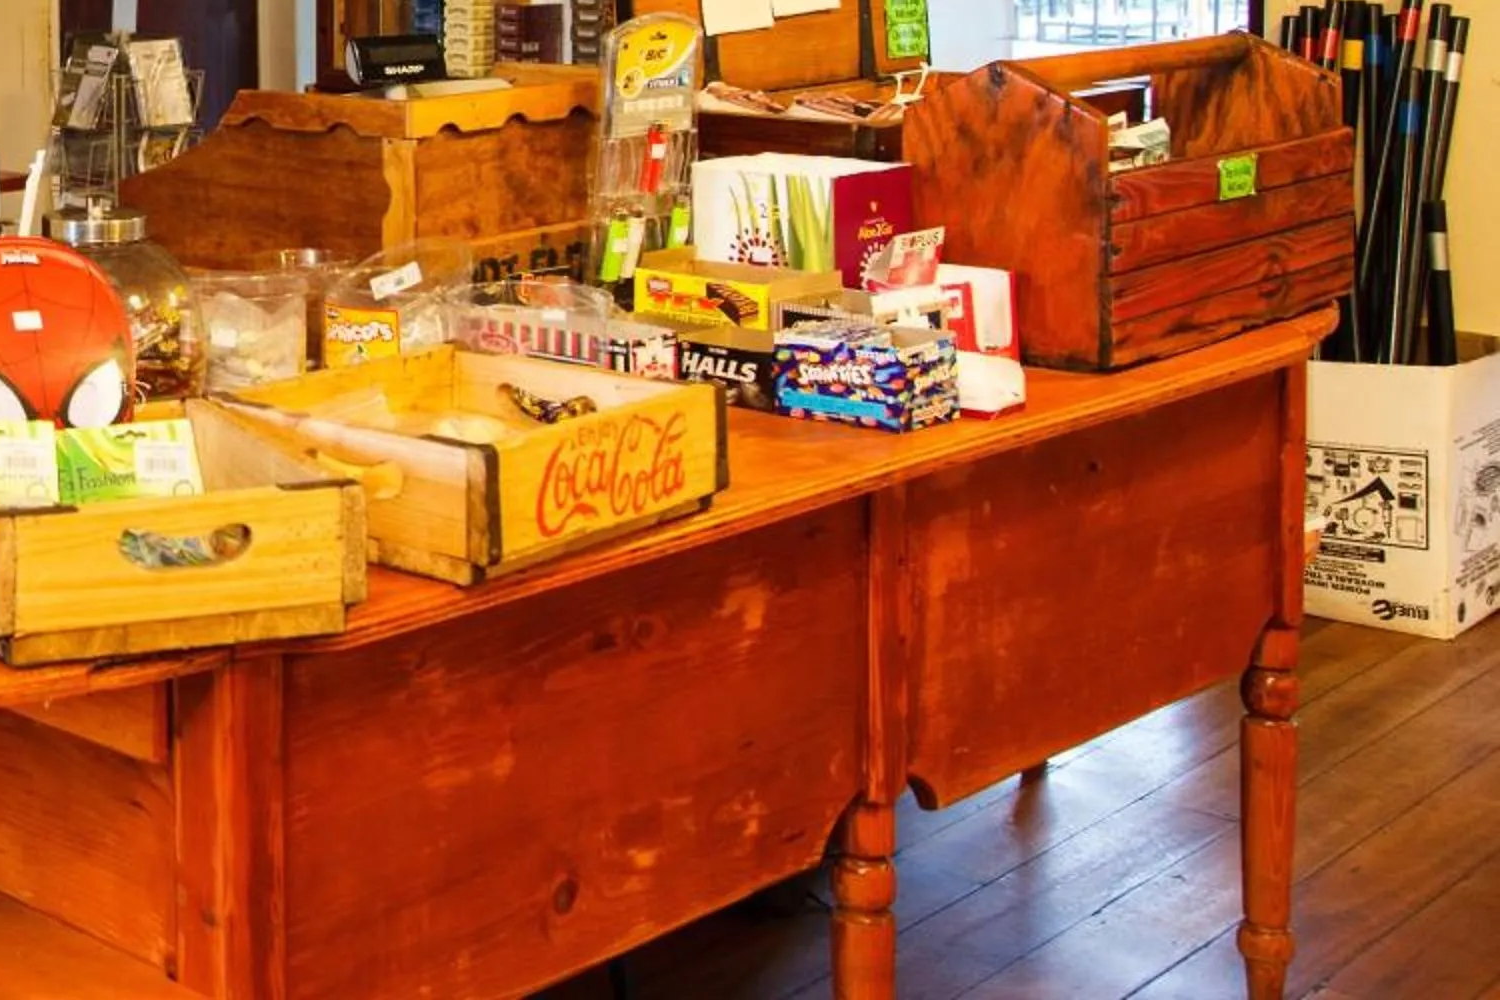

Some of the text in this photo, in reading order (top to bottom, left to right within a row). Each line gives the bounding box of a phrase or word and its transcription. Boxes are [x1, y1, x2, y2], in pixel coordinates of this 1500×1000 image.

[645, 48, 668, 62] BIC
[384, 65, 425, 76] SHARP
[681, 351, 759, 383] HALLS
